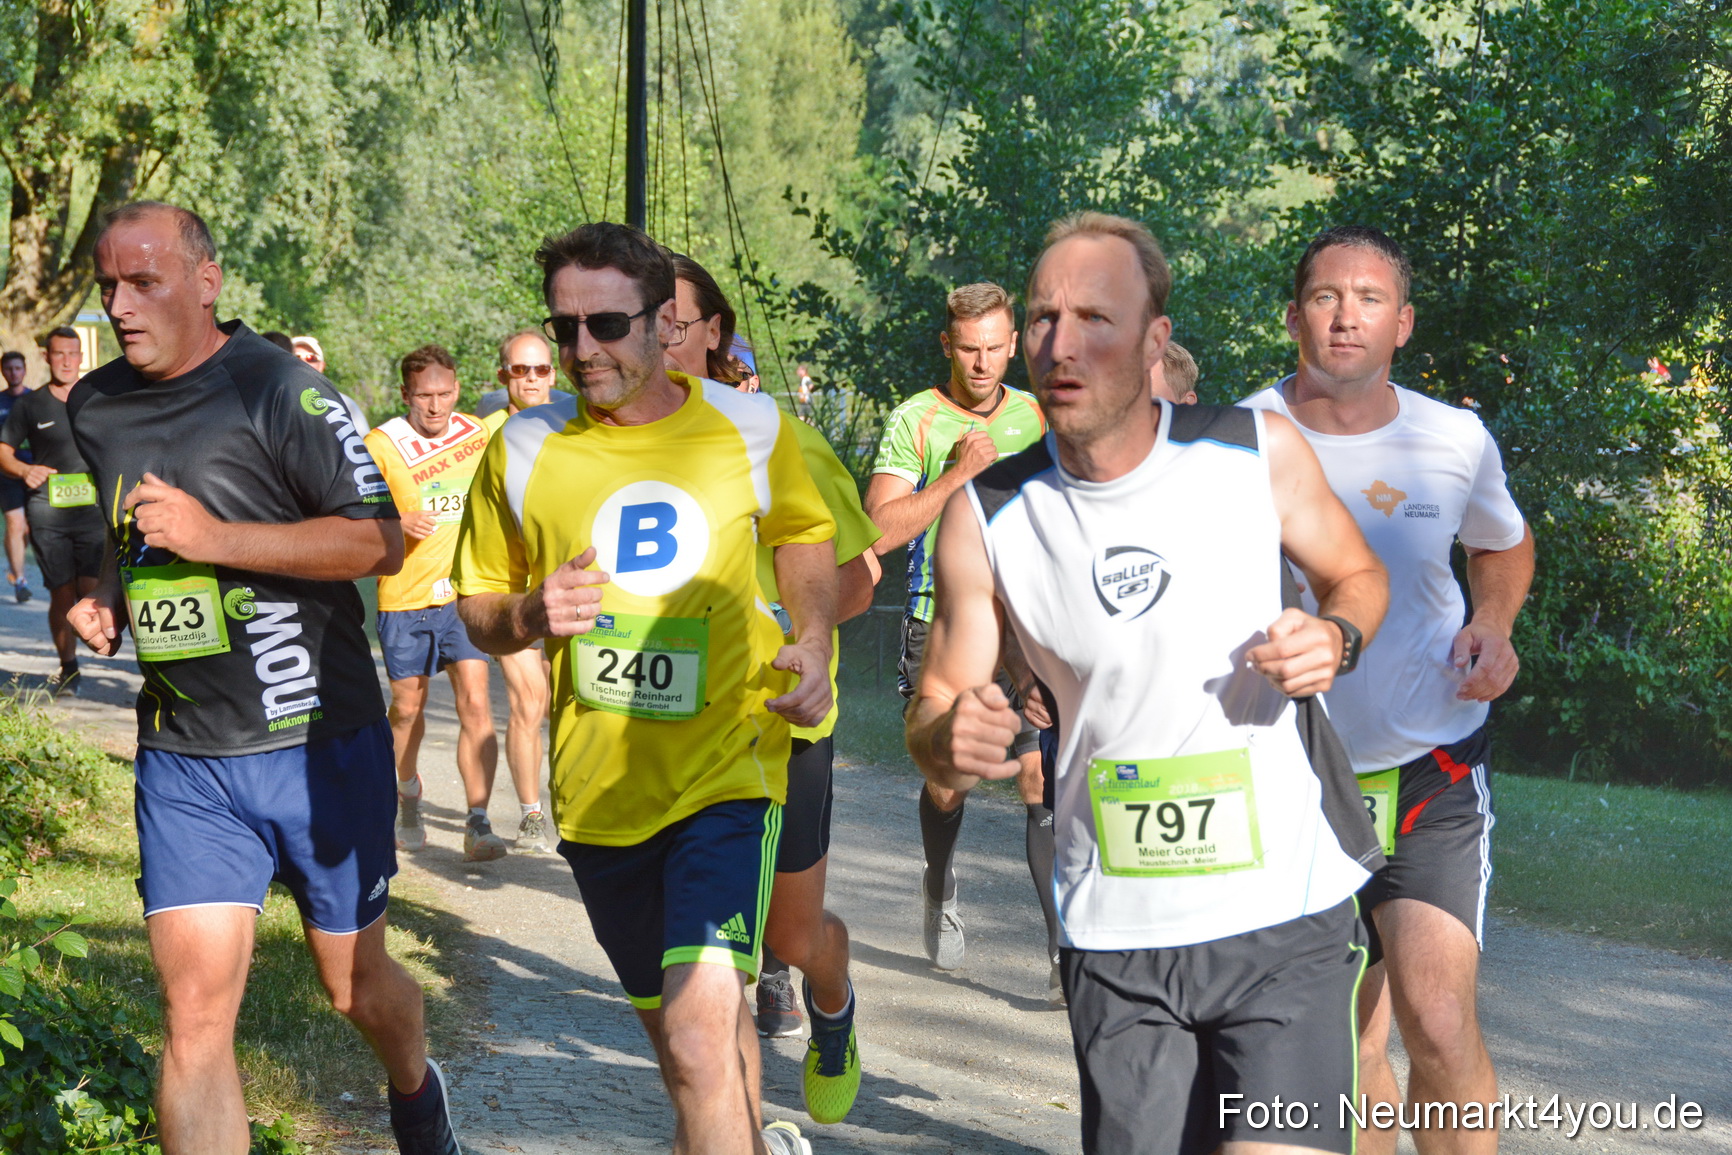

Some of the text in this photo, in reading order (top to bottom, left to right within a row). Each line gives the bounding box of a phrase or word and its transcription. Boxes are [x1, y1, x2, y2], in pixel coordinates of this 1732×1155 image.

[412, 458, 451, 486] MAX
[55, 484, 89, 497] 2035
[1375, 494, 1392, 502] NM
[1404, 504, 1440, 512] LANDKREIS
[1404, 511, 1440, 519] NEUMARKT
[616, 502, 678, 574] B
[152, 587, 174, 596] 2018
[138, 597, 205, 633] 423
[170, 631, 207, 643] Ruzdija
[597, 648, 673, 691] 240
[590, 682, 682, 702] Tischner Reinhard
[270, 700, 317, 716] by Lammsbräu
[599, 695, 645, 708] Bretschneider
[646, 702, 670, 710] GmbH
[268, 710, 324, 732] drinknow.de
[1108, 777, 1160, 789] firmenlauf
[1125, 798, 1215, 844] 797
[1138, 844, 1216, 857] Meier Gerald
[1138, 858, 1188, 867] Haustechnik
[715, 929, 750, 945] adidas
